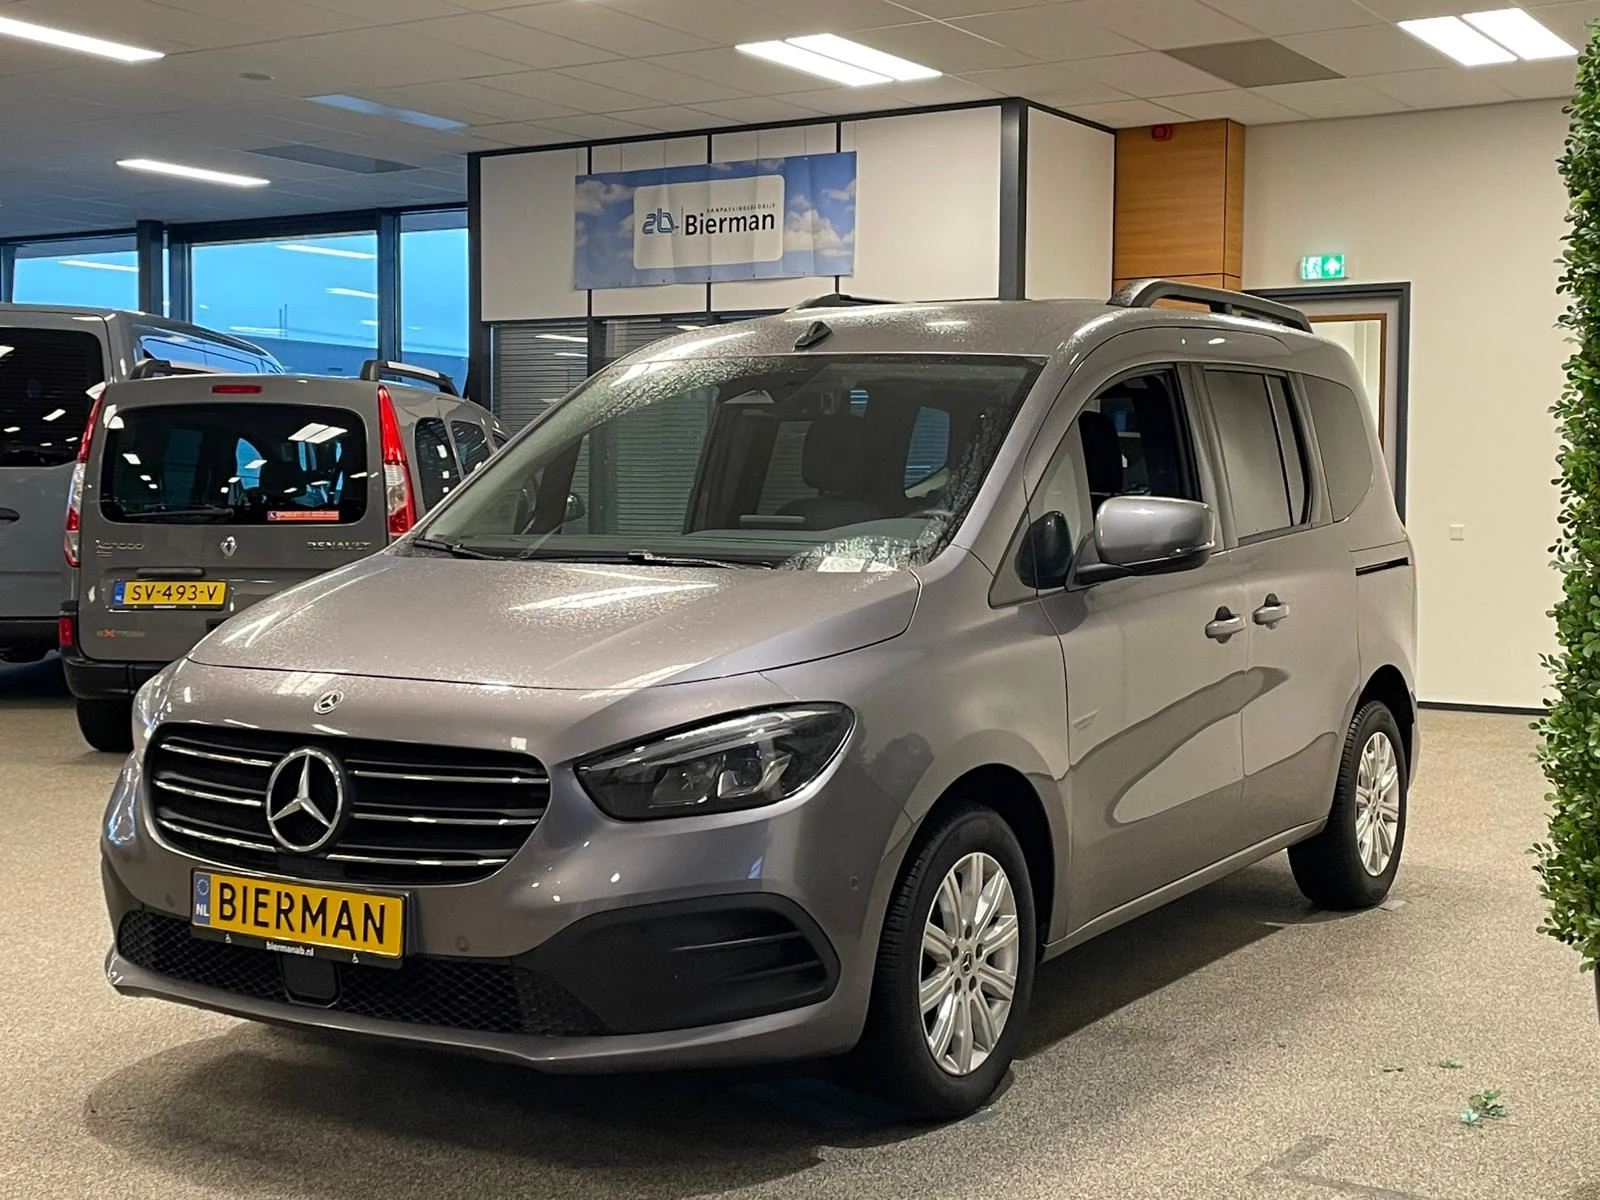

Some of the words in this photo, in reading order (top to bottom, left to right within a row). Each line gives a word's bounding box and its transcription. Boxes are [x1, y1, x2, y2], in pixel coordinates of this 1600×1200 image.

[685, 213, 775, 236] Bierman
[131, 584, 218, 601] SV-493-V
[196, 903, 210, 916] NL
[218, 882, 386, 945] BIERMAN
[266, 940, 314, 957] biermanab.nl
